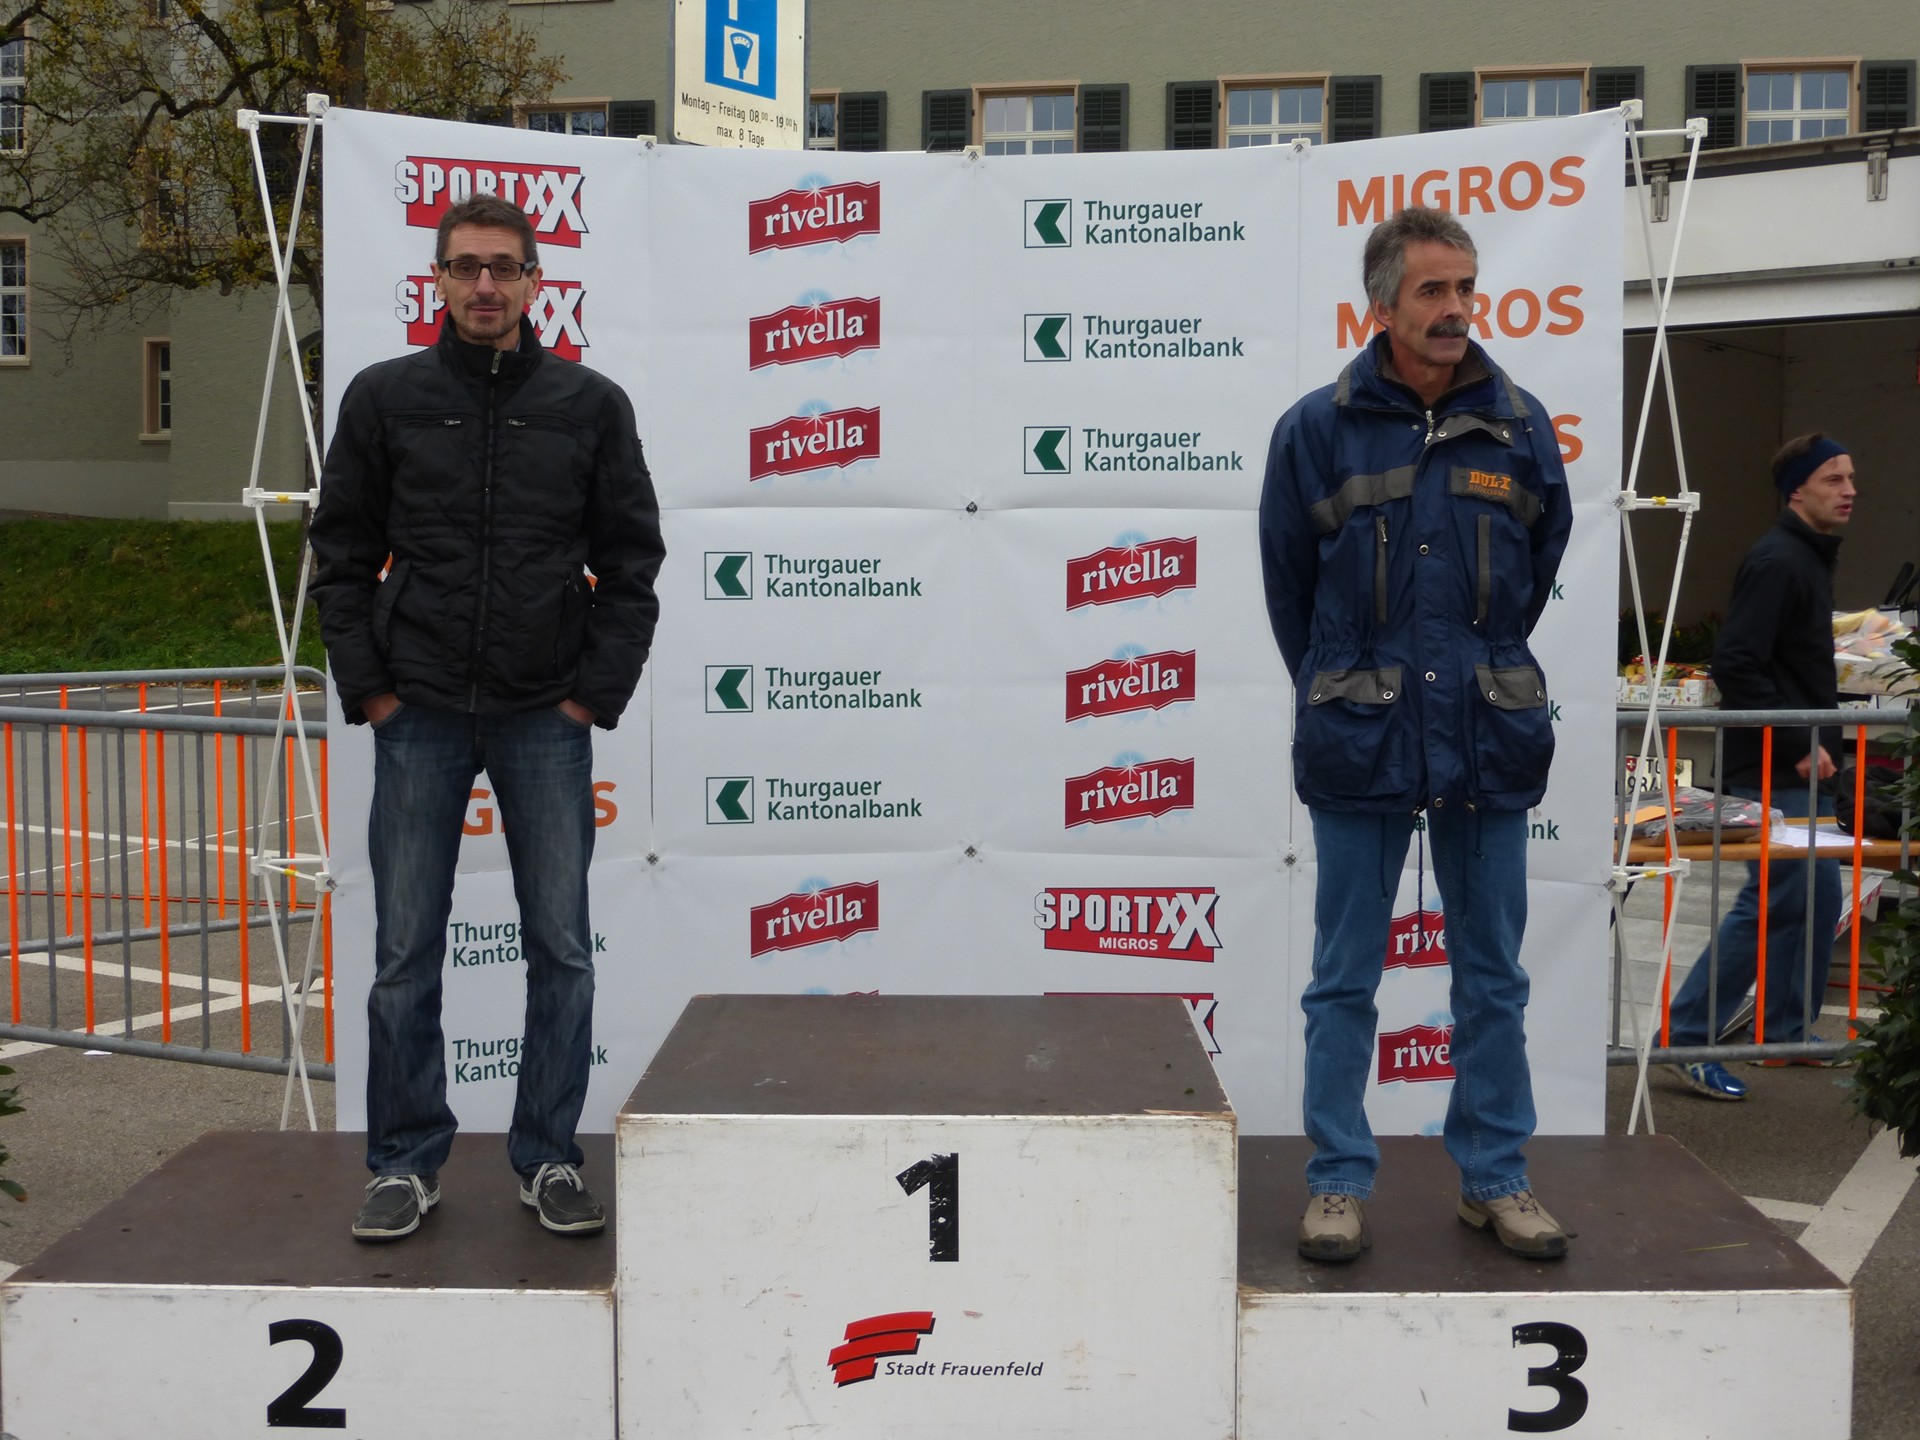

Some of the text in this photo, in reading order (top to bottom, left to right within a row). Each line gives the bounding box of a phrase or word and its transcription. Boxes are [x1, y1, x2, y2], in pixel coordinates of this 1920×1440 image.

[681, 92, 710, 114] Montag
[719, 102, 746, 123] Freitag
[717, 125, 765, 148] max. 8 Tage
[1337, 155, 1586, 227] MIGROS
[764, 193, 865, 237] rivella
[1083, 200, 1203, 224] Thurgauer
[1085, 221, 1246, 244] Kantonalbank
[765, 307, 865, 353] rivella
[1082, 315, 1202, 339] Thurgauer
[1336, 285, 1585, 350] MROS
[1085, 336, 1245, 359] Kantonalbank
[765, 418, 865, 463] rivella
[1082, 428, 1201, 452] Thurgauer
[1084, 451, 1244, 472] Kantonalbank
[764, 554, 881, 579] Thurgauer
[1081, 548, 1181, 593] rivella
[766, 577, 923, 597] Kantonalbank
[764, 667, 881, 691] Thurgauer
[1080, 661, 1180, 705] rivella
[767, 688, 923, 710] Kantonalbank
[765, 778, 882, 802] Thurgauer
[1079, 768, 1179, 812] rivella
[767, 798, 923, 821] Kantonalbank
[765, 893, 864, 940] rivella
[1034, 892, 1224, 950] SPORTXX
[449, 922, 523, 944] Thurg
[1098, 936, 1159, 950] MIGROS
[1395, 924, 1446, 955] rive
[452, 1037, 525, 1060] Thurg
[1393, 1038, 1451, 1068] rive
[895, 1152, 960, 1262] 1
[267, 1318, 346, 1429] 2
[884, 1361, 1044, 1376] Stadt Frauenfeld
[1507, 1321, 1589, 1433] 3
